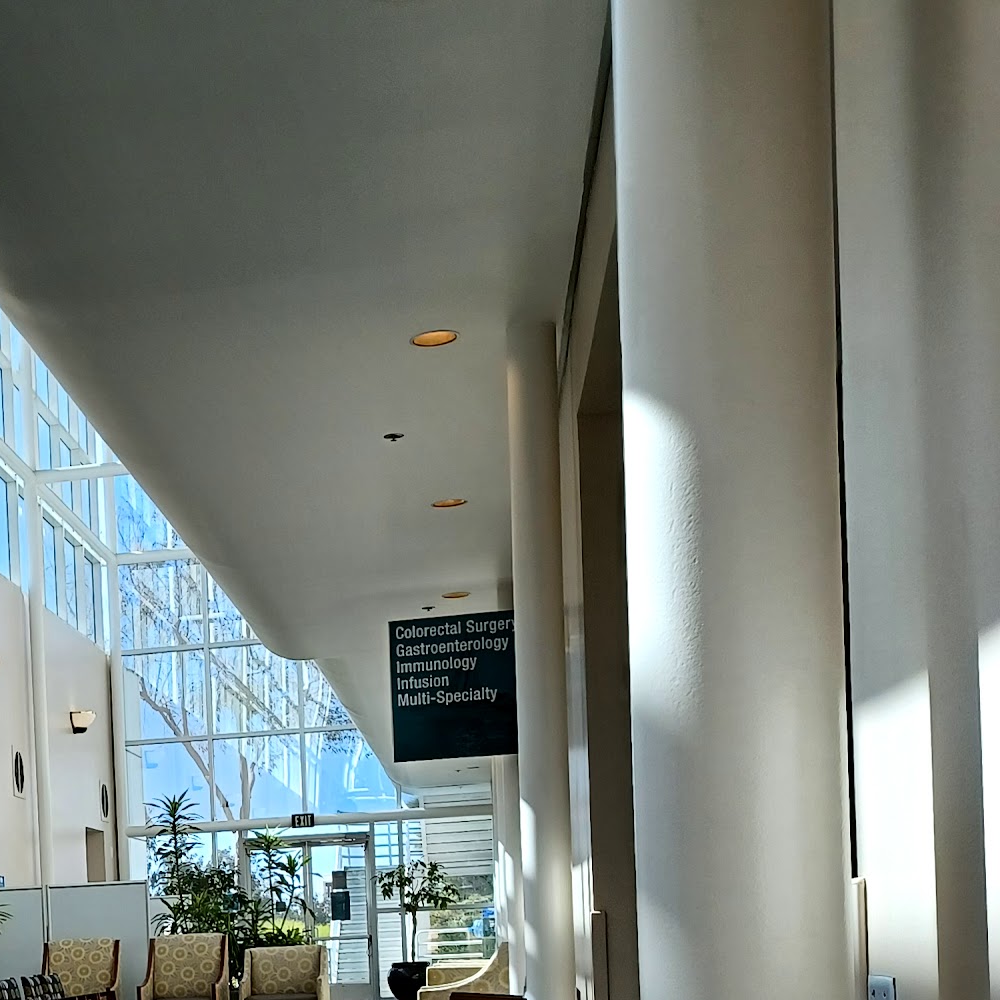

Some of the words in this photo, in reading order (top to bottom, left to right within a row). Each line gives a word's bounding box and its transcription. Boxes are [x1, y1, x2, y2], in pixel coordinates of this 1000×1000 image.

[395, 621, 462, 640] Colorectal
[396, 636, 509, 657] Gastroenterology
[396, 656, 477, 673] Immunology
[396, 674, 450, 690] Infusion
[397, 686, 498, 707] Multi-Specialty
[294, 815, 312, 827] EXIT
